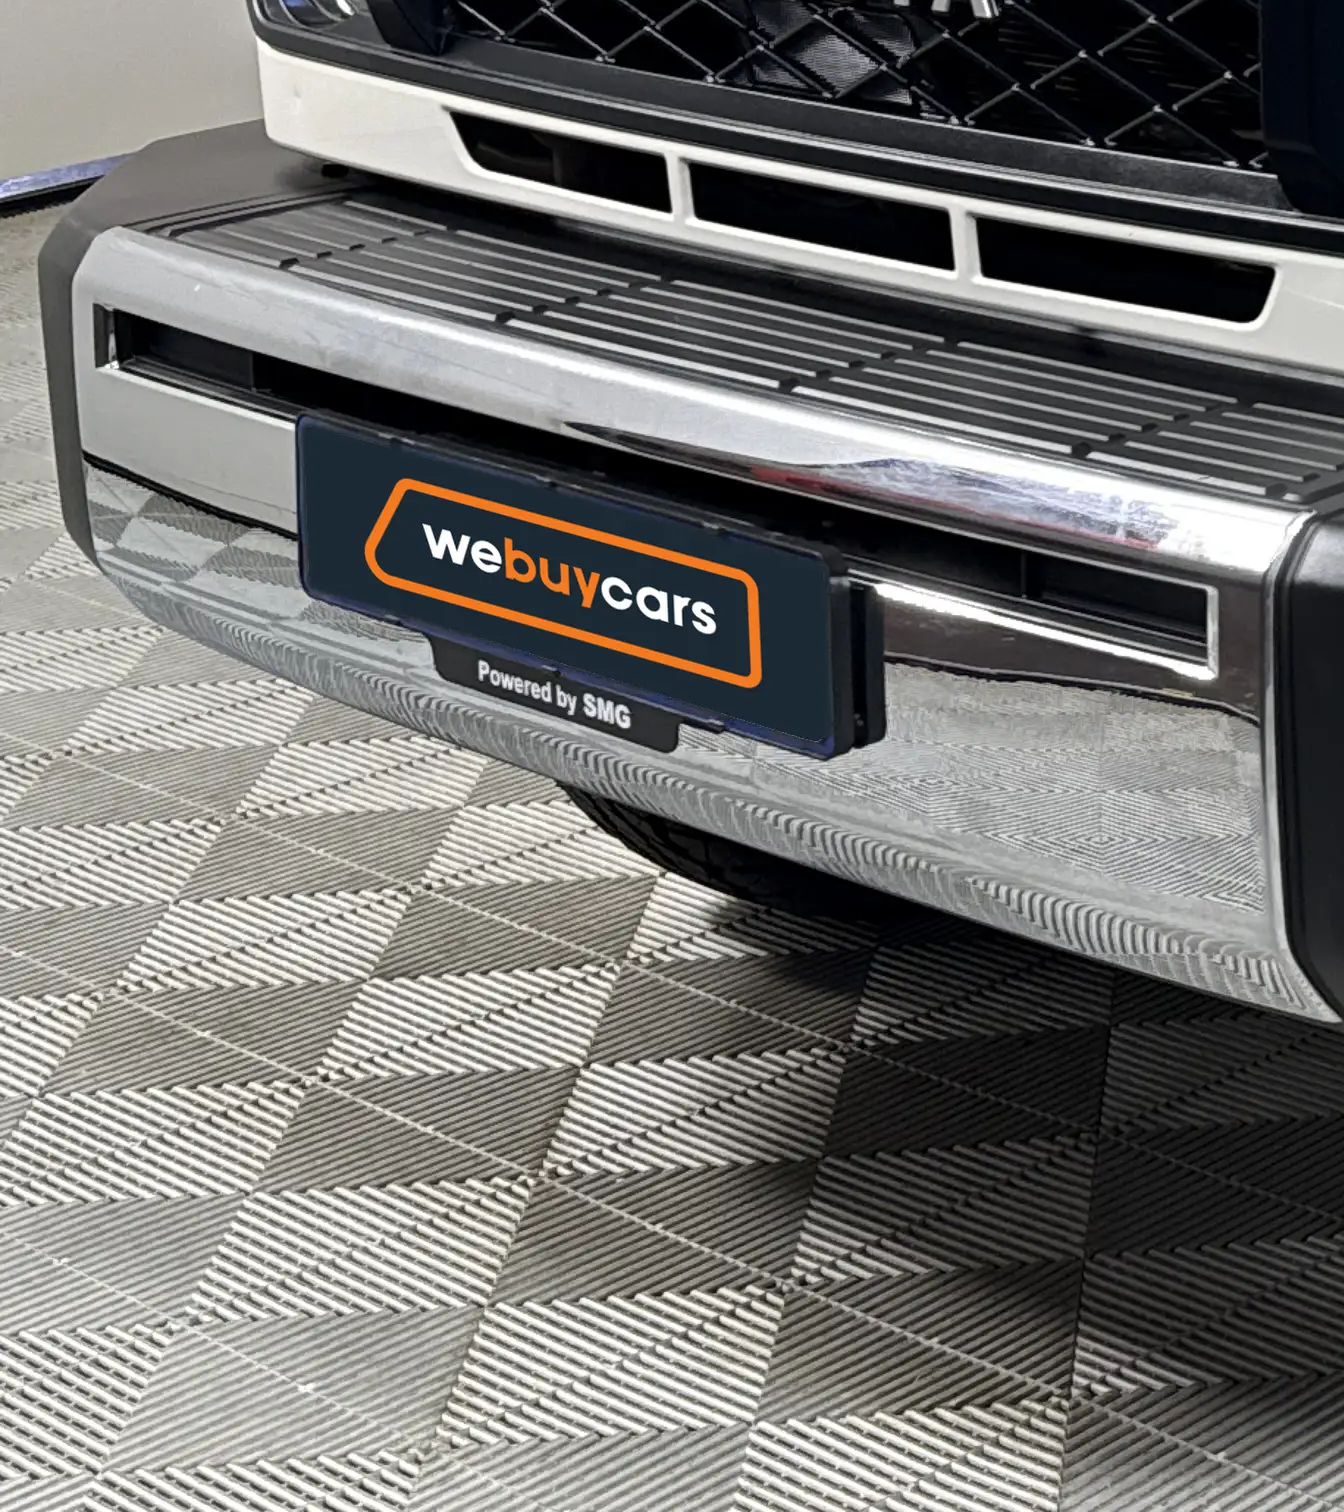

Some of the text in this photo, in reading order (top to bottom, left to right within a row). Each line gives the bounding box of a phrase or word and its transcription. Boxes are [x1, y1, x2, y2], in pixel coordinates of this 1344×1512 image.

[477, 659, 632, 730] Powered by SMG
